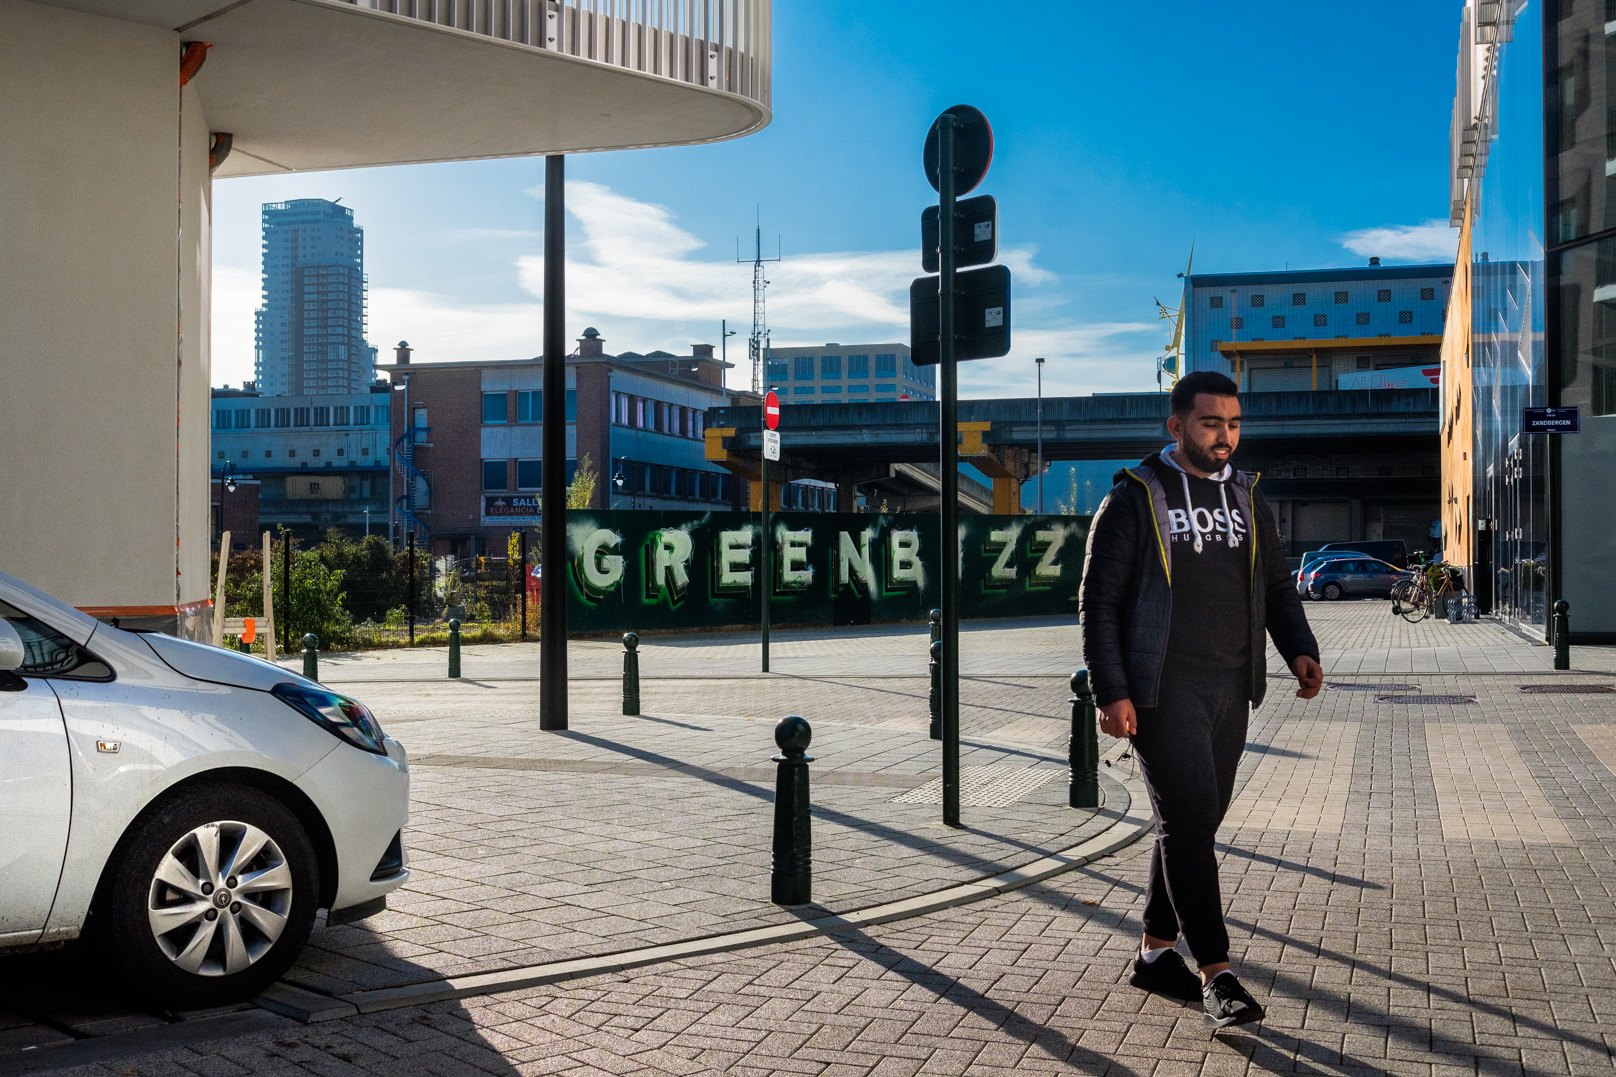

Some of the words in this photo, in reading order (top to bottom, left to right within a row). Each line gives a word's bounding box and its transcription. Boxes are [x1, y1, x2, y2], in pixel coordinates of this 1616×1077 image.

[512, 498, 539, 506] SALL
[1168, 507, 1247, 533] BOSS
[1171, 534, 1212, 542] HUO
